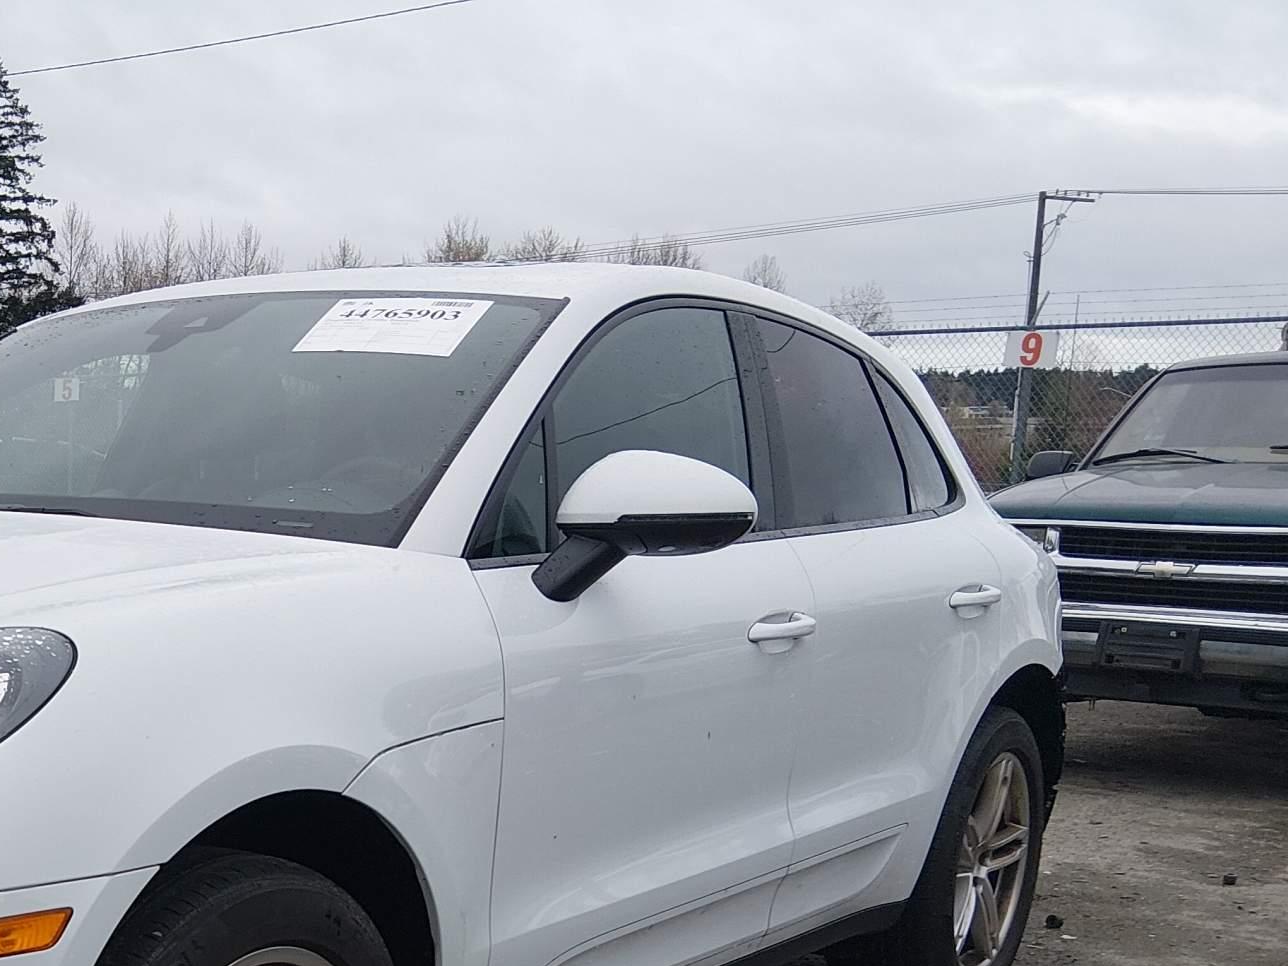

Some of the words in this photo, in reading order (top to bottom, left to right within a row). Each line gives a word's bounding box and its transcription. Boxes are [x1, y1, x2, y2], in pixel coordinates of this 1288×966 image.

[339, 308, 462, 321] 44765903
[1019, 332, 1043, 366] 9
[62, 379, 73, 400] 5
